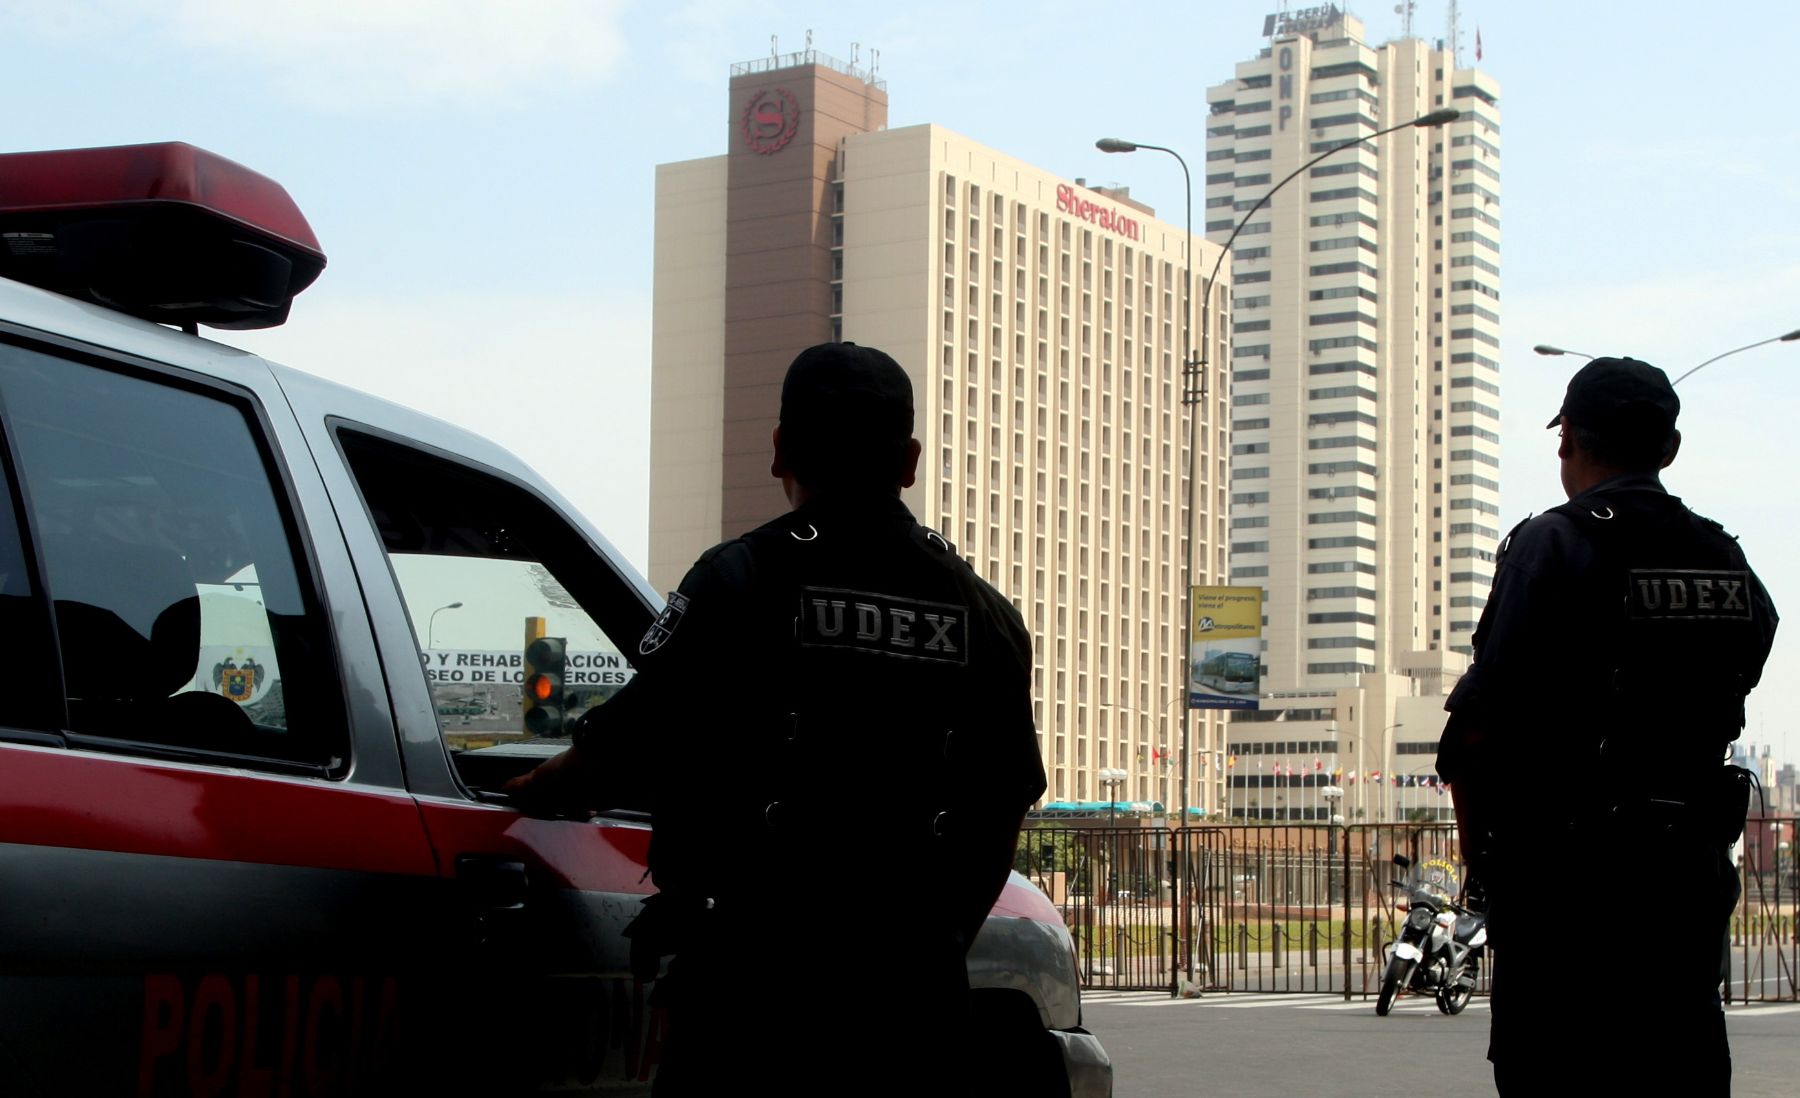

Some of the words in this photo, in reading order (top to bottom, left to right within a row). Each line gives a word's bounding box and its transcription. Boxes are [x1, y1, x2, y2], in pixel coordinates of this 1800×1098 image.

[1279, 11, 1293, 22] EL
[1296, 2, 1329, 20] PERÚ
[1056, 183, 1139, 242] Sheraton
[1637, 579, 1745, 609] UDEX
[812, 598, 958, 653] UDEX
[438, 653, 449, 666] Y
[471, 670, 496, 682] DE
[1422, 859, 1457, 881] POLICIA
